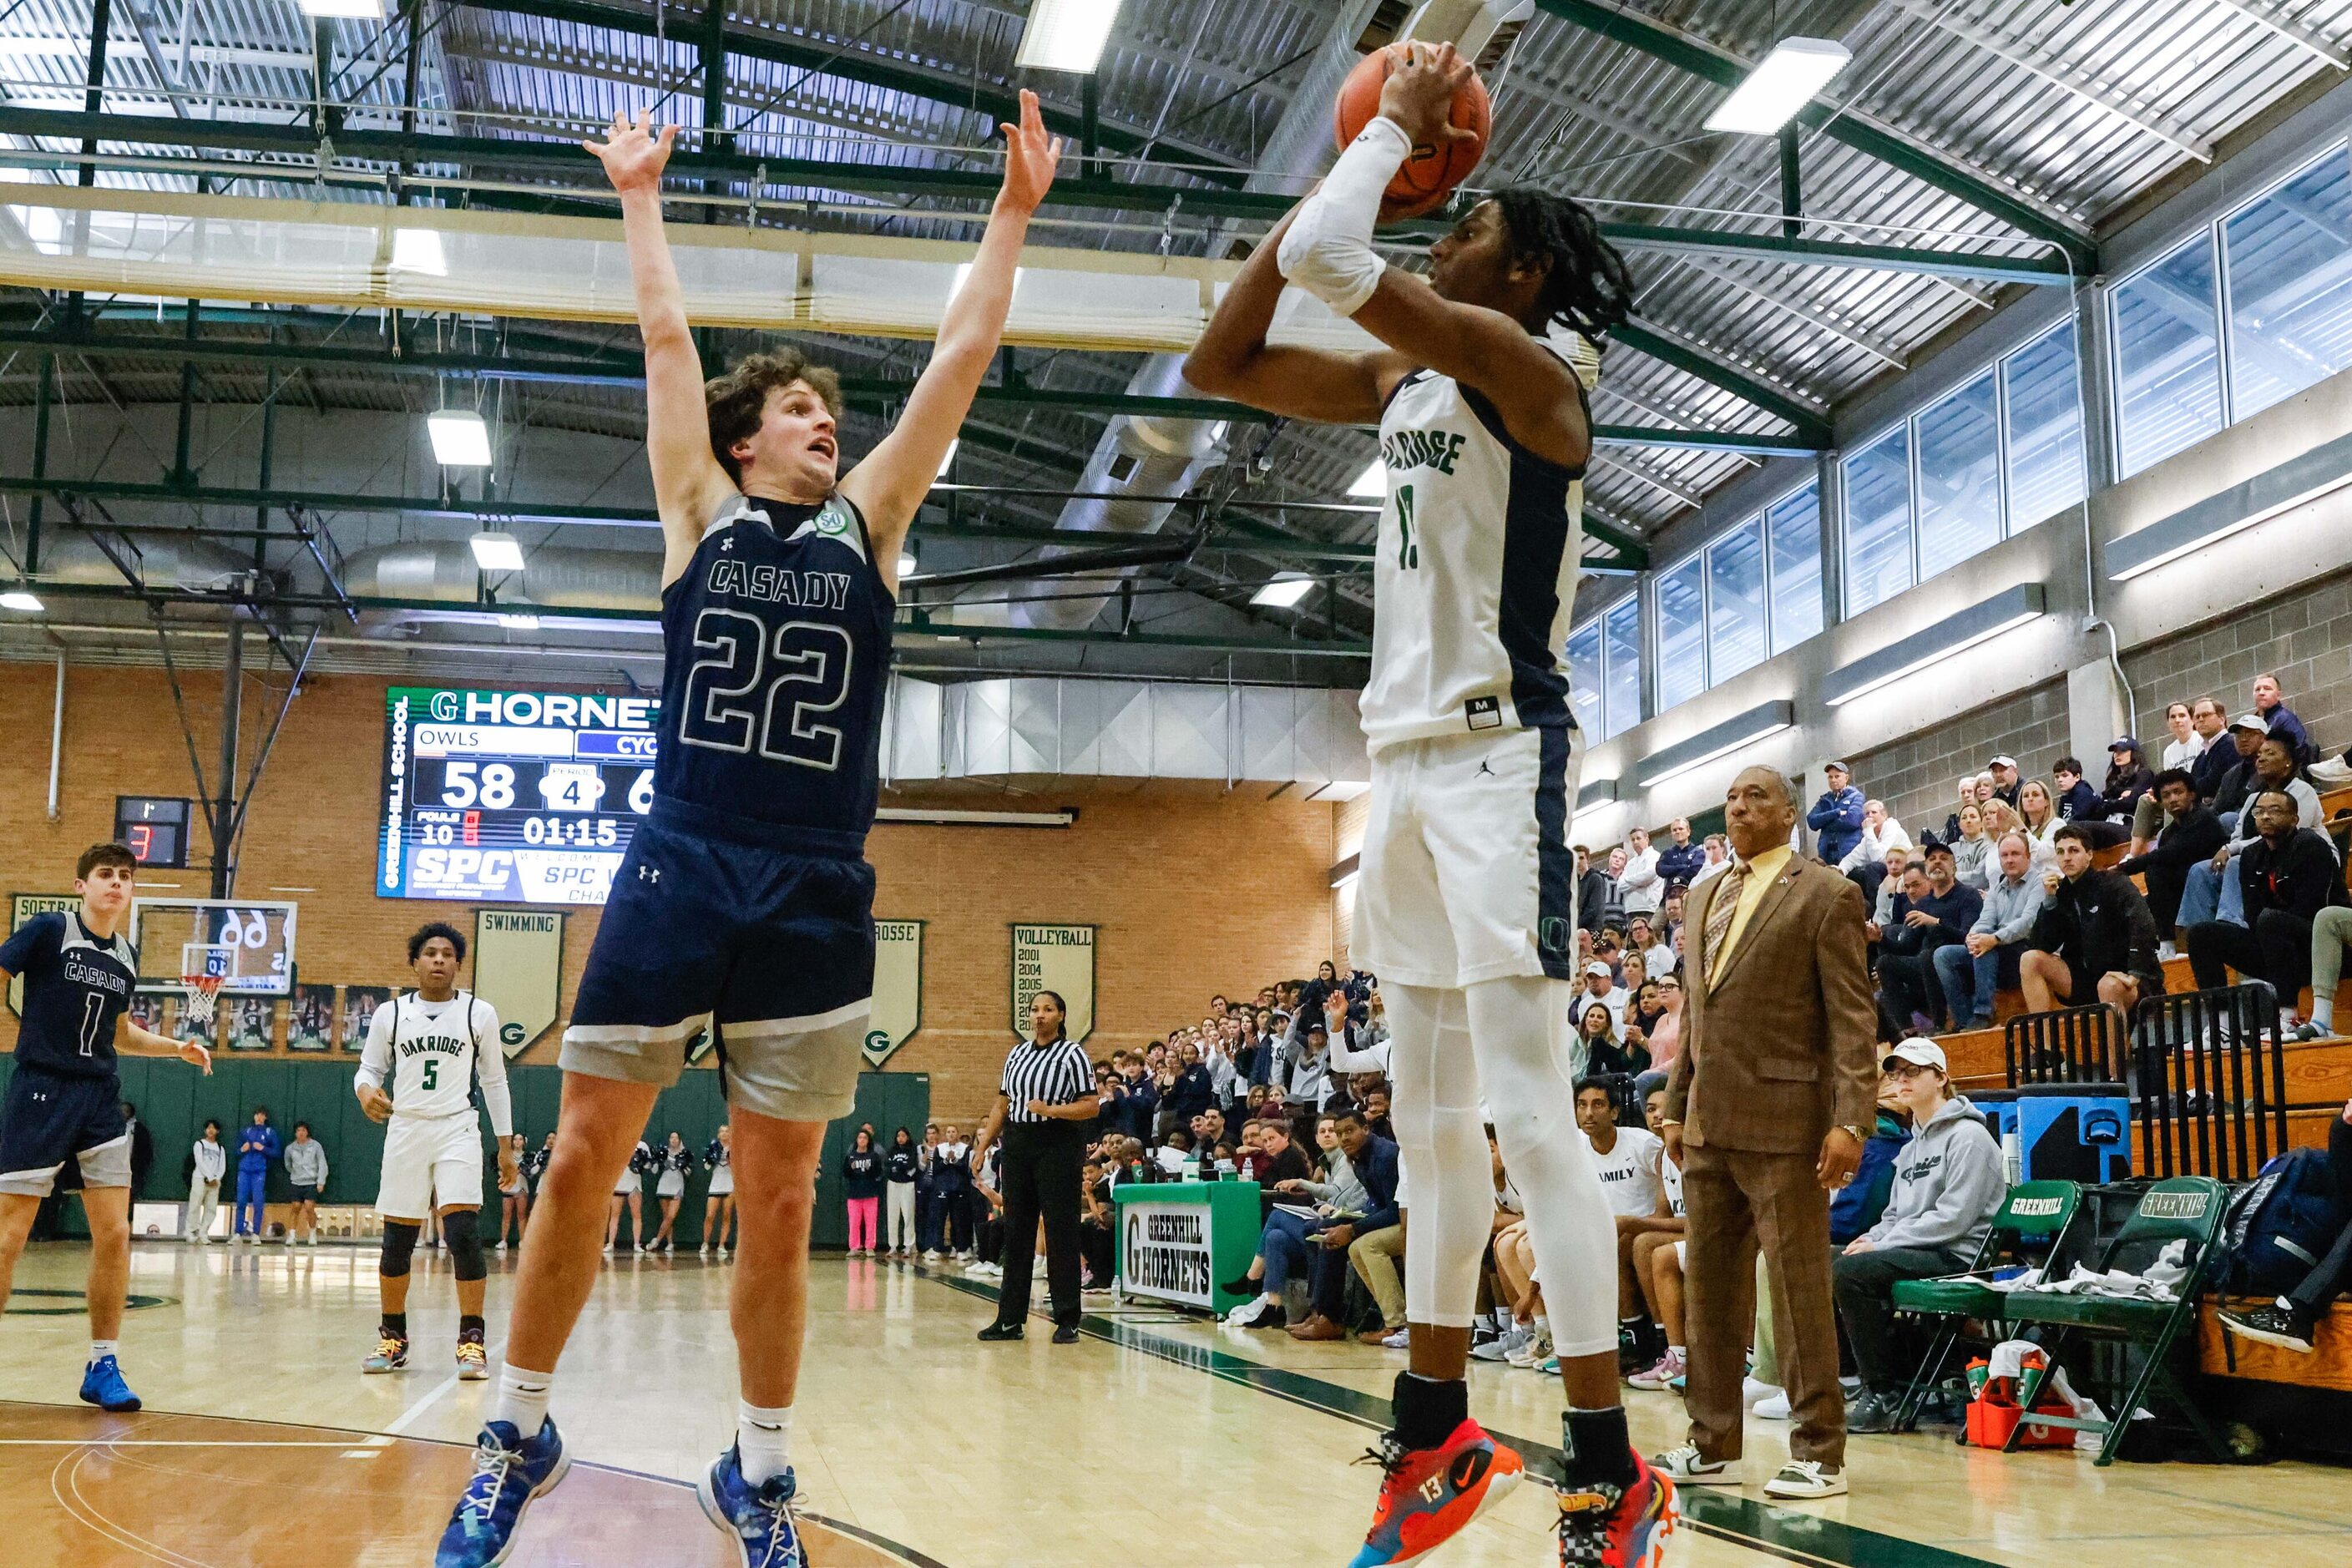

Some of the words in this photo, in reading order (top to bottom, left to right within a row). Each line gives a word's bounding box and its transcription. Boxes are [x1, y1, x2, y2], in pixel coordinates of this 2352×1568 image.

[708, 559, 851, 610] CASADY
[679, 607, 853, 772] 22
[1474, 700, 1488, 711] M
[390, 695, 408, 776] SCHOOL
[420, 731, 479, 746] OWLS
[552, 767, 594, 776] PERIOD
[441, 761, 516, 810] 58
[563, 781, 581, 805] 4
[628, 768, 655, 815] 6
[421, 824, 453, 845] 10
[523, 817, 618, 847] 01:15
[412, 848, 513, 884] SPC
[544, 867, 595, 884] SPC
[485, 914, 554, 933] SWIMMING
[1017, 929, 1091, 946] VOLLEYBALL
[1018, 948, 1039, 961] 2001
[64, 962, 125, 994] CASADY
[1019, 964, 1041, 976] 2004
[1019, 979, 1042, 990] 2005
[1019, 1006, 1030, 1018] 20
[79, 991, 105, 1057] 1
[1019, 1019, 1031, 1032] 20
[400, 1035, 466, 1058] OAKRIDGE
[864, 1028, 891, 1053] G
[422, 1060, 439, 1090] 5
[1598, 1166, 1636, 1182] MILY
[2010, 1197, 2063, 1216] GREENHILL
[2142, 1194, 2208, 1216] GREENHILL
[1127, 1213, 1141, 1286] G
[1147, 1214, 1203, 1244] GREENHILL
[1141, 1246, 1210, 1296] HORNETS
[1419, 1475, 1443, 1504] 13
